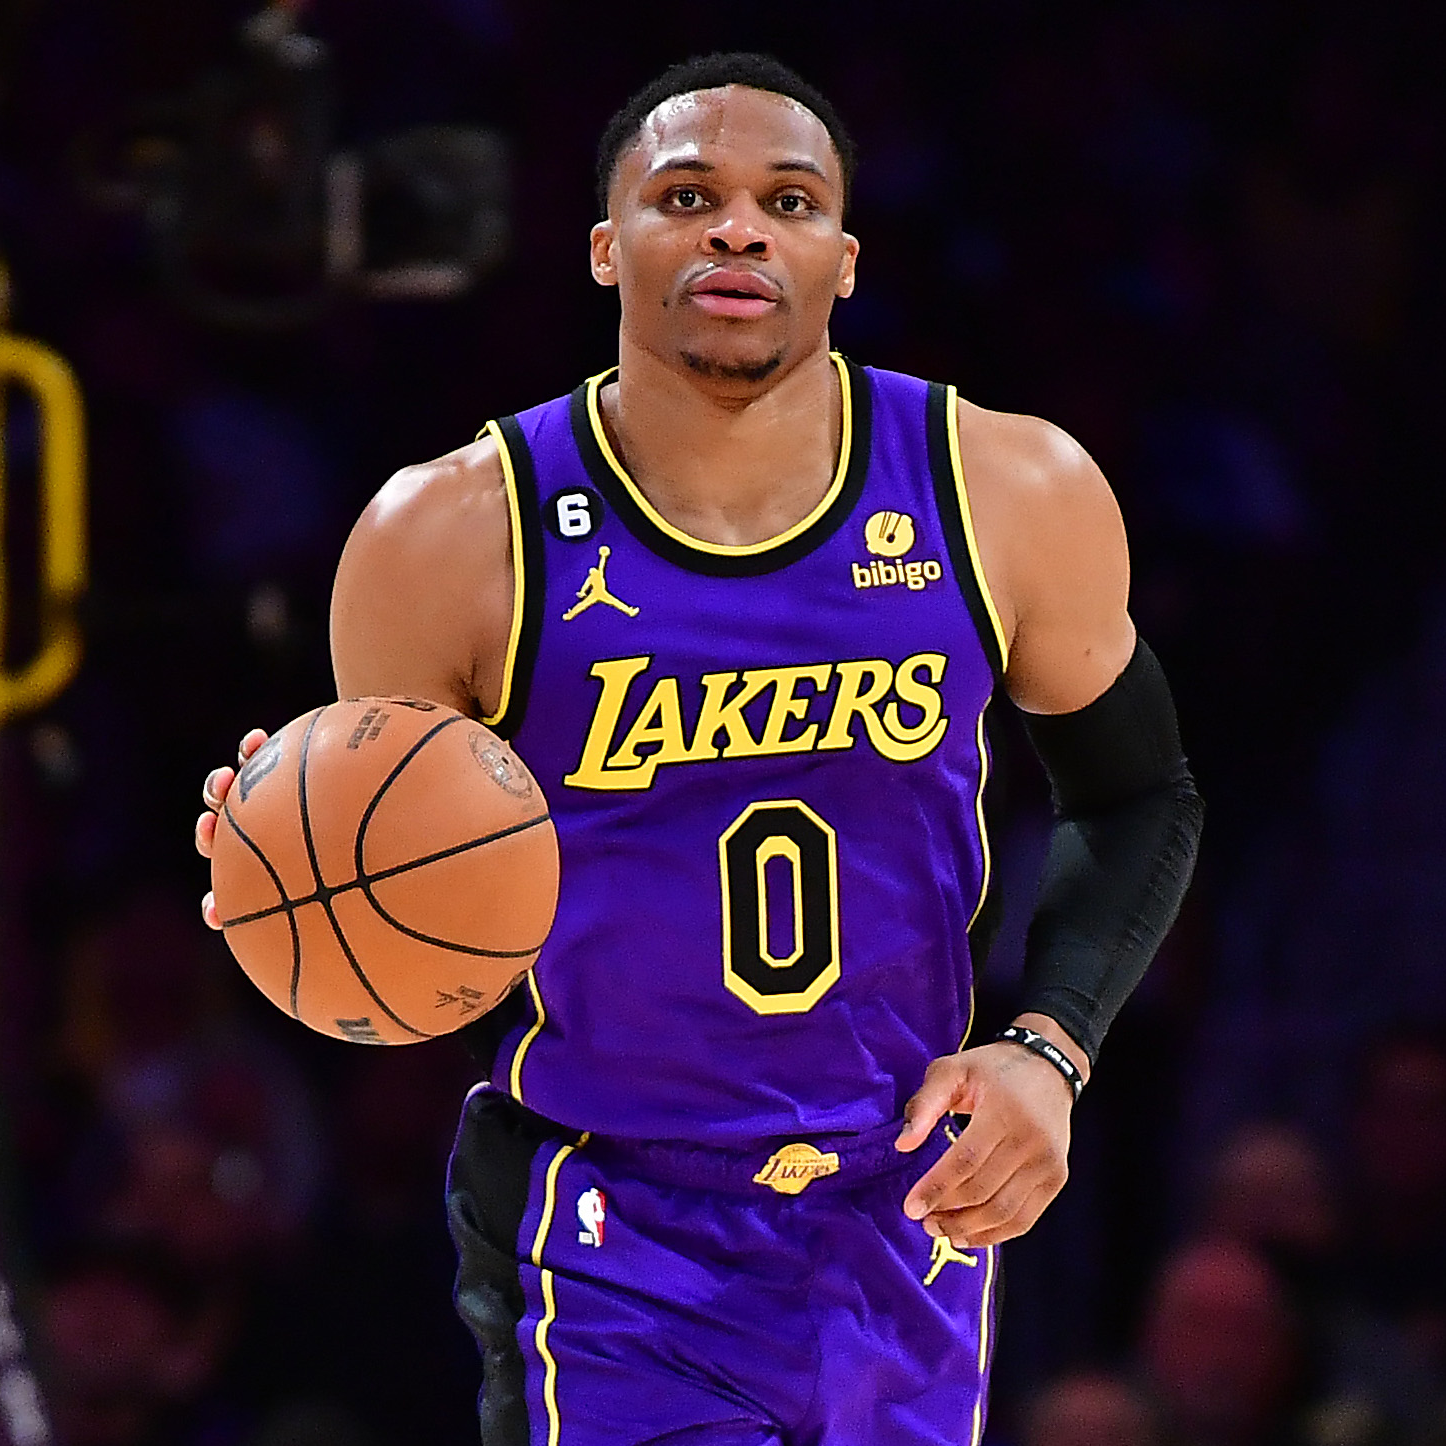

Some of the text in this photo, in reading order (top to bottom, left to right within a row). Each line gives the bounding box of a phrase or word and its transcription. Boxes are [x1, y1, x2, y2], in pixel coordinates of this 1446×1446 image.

[556, 493, 592, 537] 6
[852, 558, 941, 590] bibigo
[564, 653, 948, 790] LAKERS
[717, 798, 842, 1016] 0
